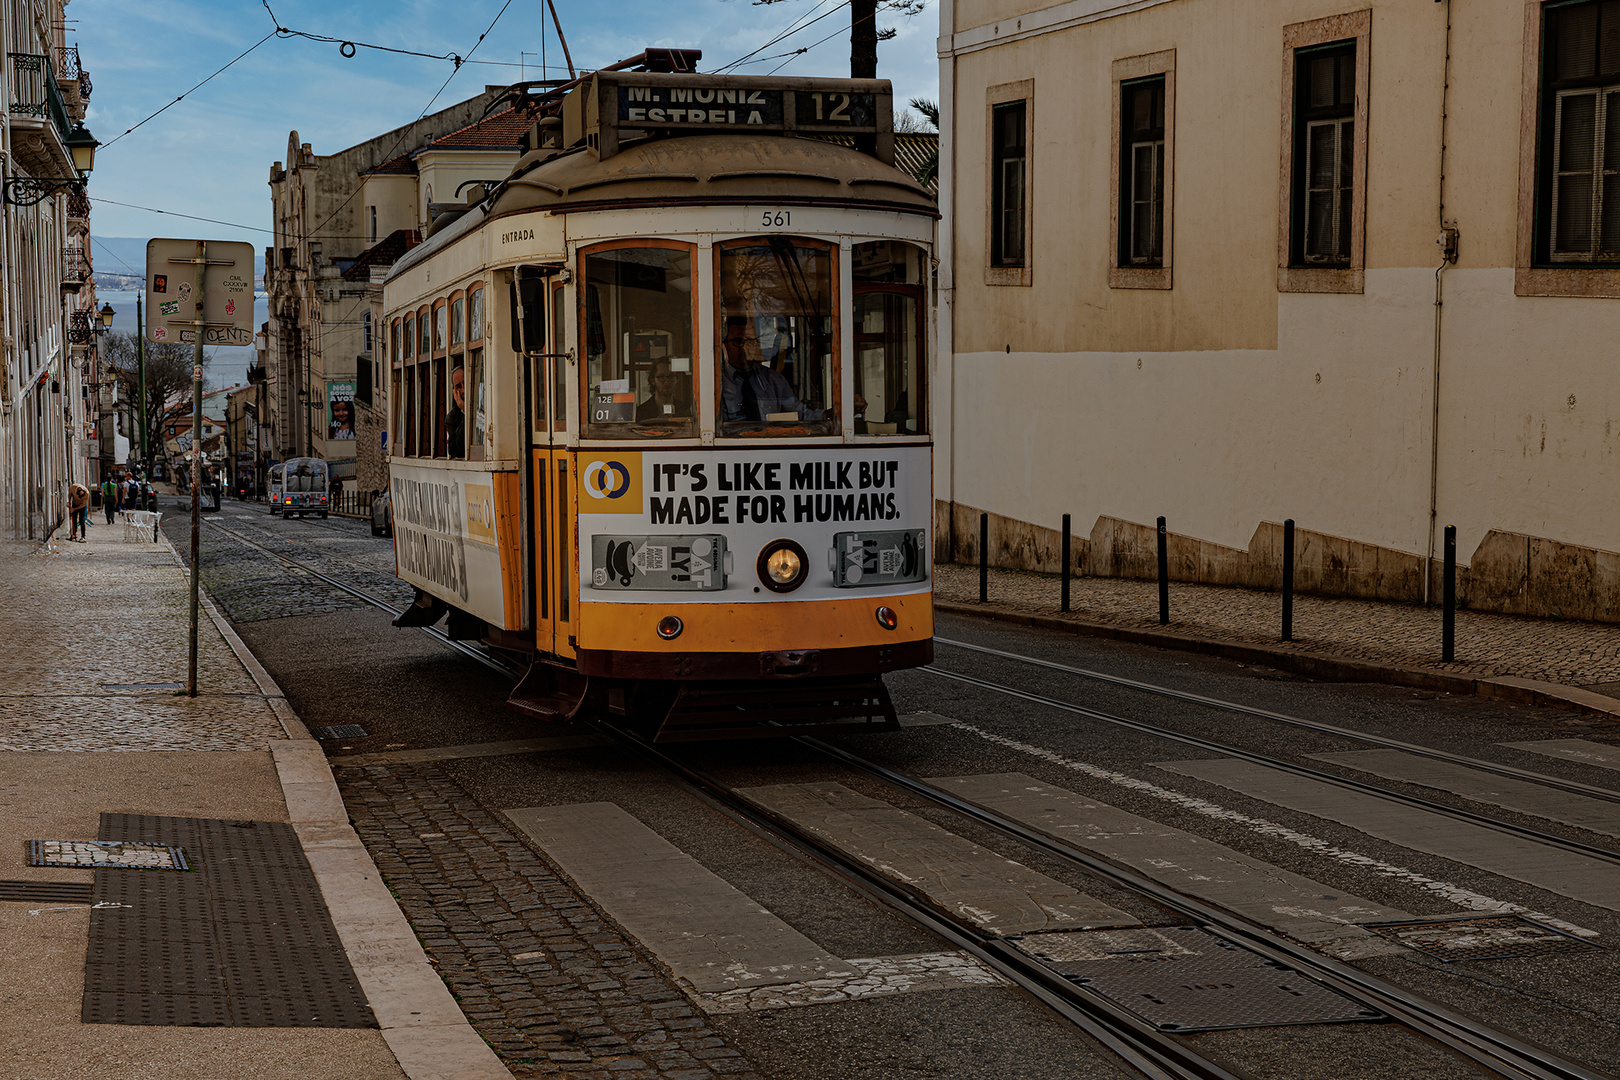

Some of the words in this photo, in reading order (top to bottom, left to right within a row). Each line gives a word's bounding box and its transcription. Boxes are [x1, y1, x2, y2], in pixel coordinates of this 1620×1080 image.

[628, 87, 660, 102] M.
[670, 88, 766, 104] MONIZ
[811, 92, 851, 121] 12
[762, 211, 791, 226] 561
[502, 229, 534, 244] ENTRADA
[596, 410, 609, 420] 01
[653, 463, 708, 492] IT'S
[717, 463, 781, 491] LIKE
[789, 461, 853, 490] MILK
[859, 460, 899, 489] BUT
[435, 484, 450, 535] BUT
[650, 495, 730, 524] MADE
[736, 495, 787, 523] FOR
[793, 492, 900, 523] HUMANS.
[397, 526, 416, 574] MADE
[413, 531, 428, 578] FOR
